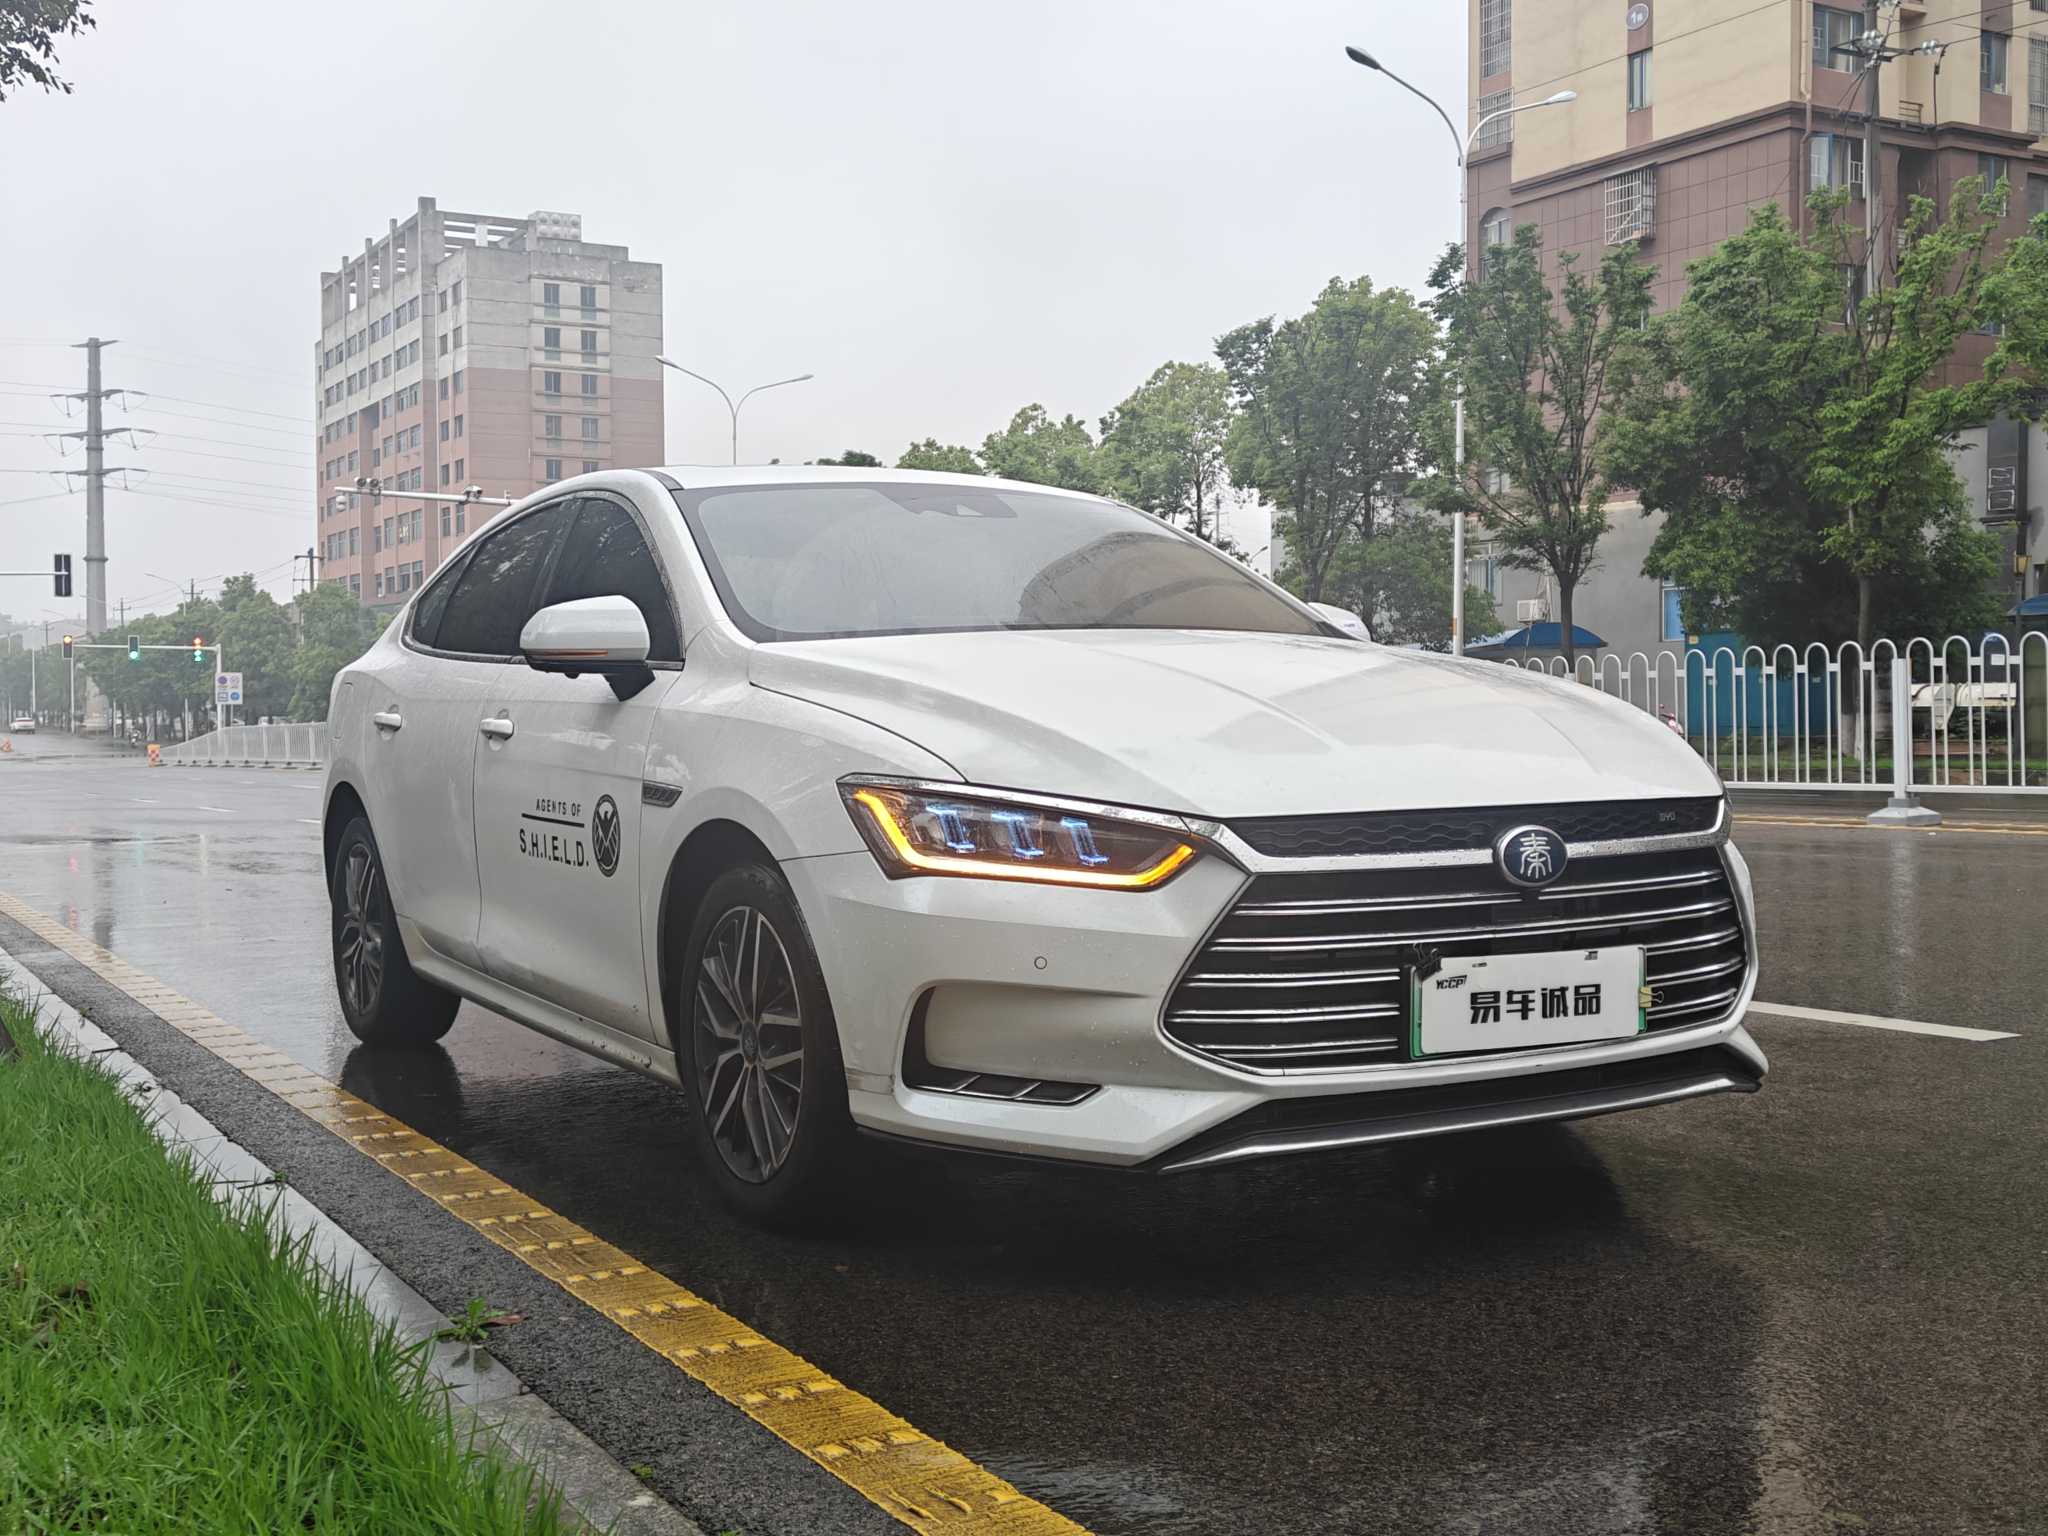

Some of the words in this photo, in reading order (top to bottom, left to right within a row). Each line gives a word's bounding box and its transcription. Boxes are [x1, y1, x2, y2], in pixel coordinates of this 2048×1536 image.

[536, 798, 567, 815] AGENTS
[571, 802, 581, 817] OF
[519, 827, 590, 867] S.H.I.E.L.D.
[1436, 976, 1467, 990] YCCP
[1470, 983, 1602, 1025] 易车诚品
